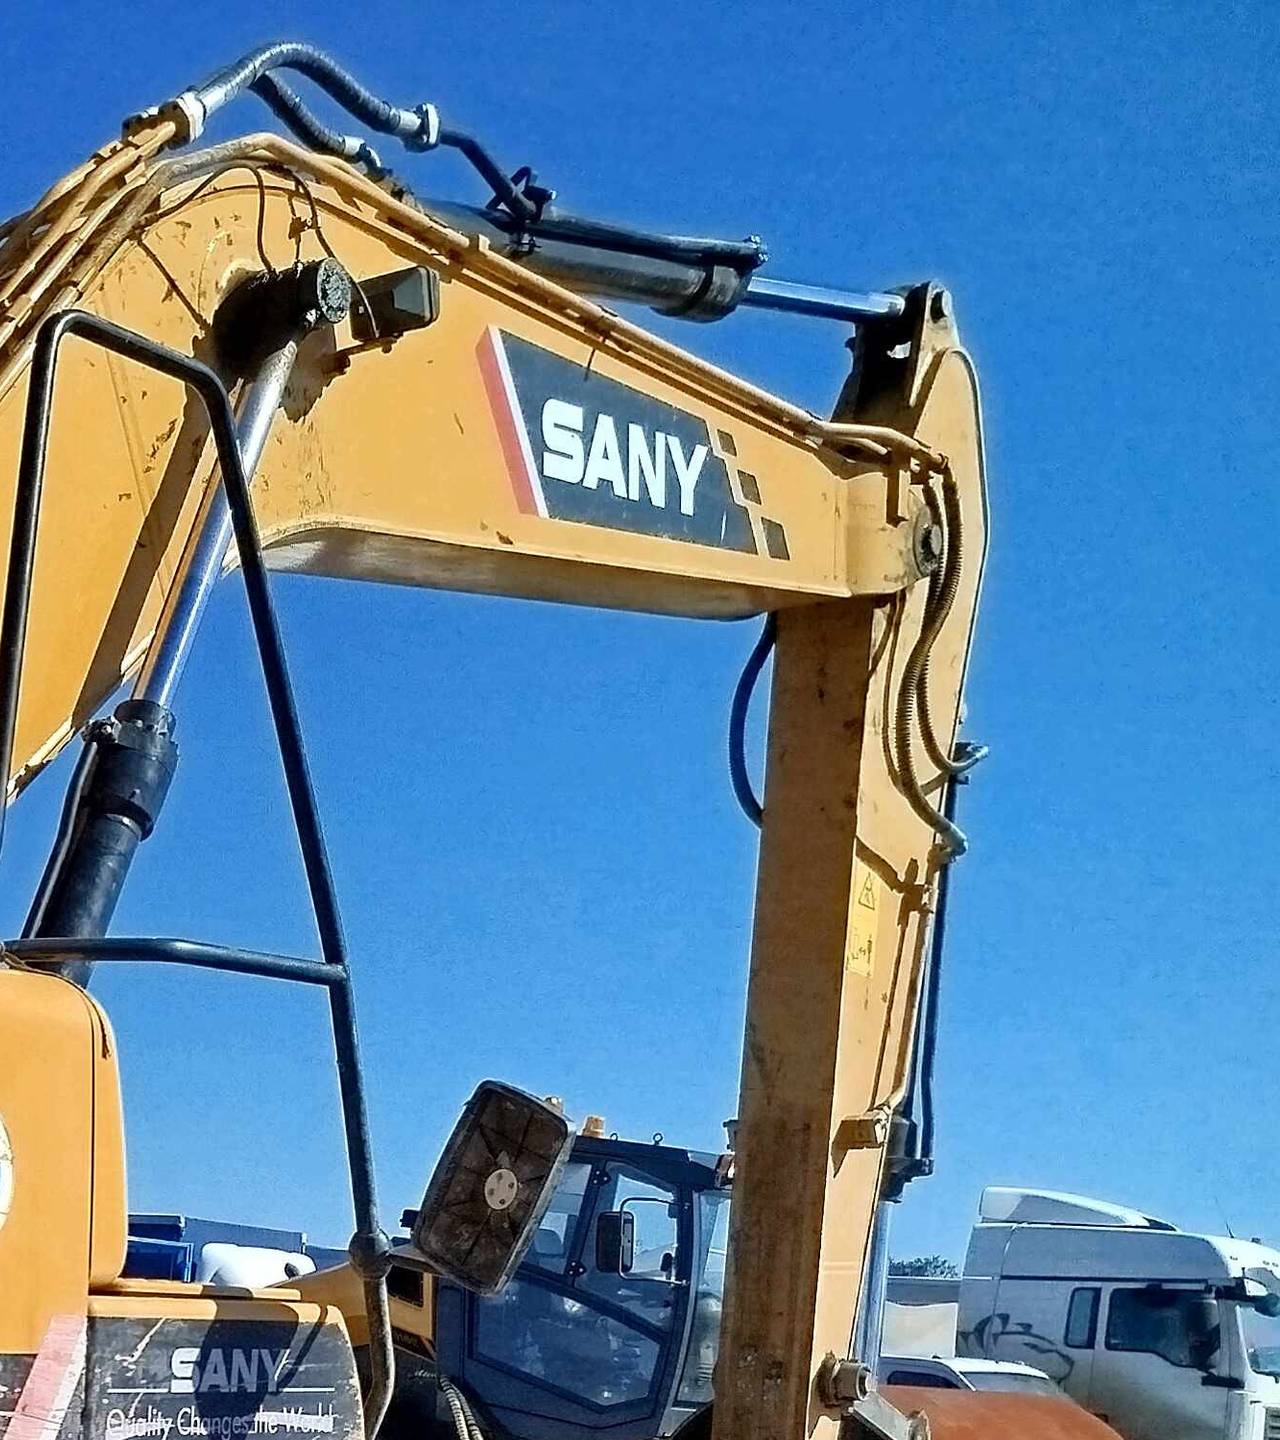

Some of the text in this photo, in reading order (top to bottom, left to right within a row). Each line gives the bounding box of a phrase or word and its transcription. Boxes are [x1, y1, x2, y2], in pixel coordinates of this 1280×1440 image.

[541, 397, 709, 518] SANY
[171, 1347, 291, 1394] SANY
[252, 1404, 279, 1434] the
